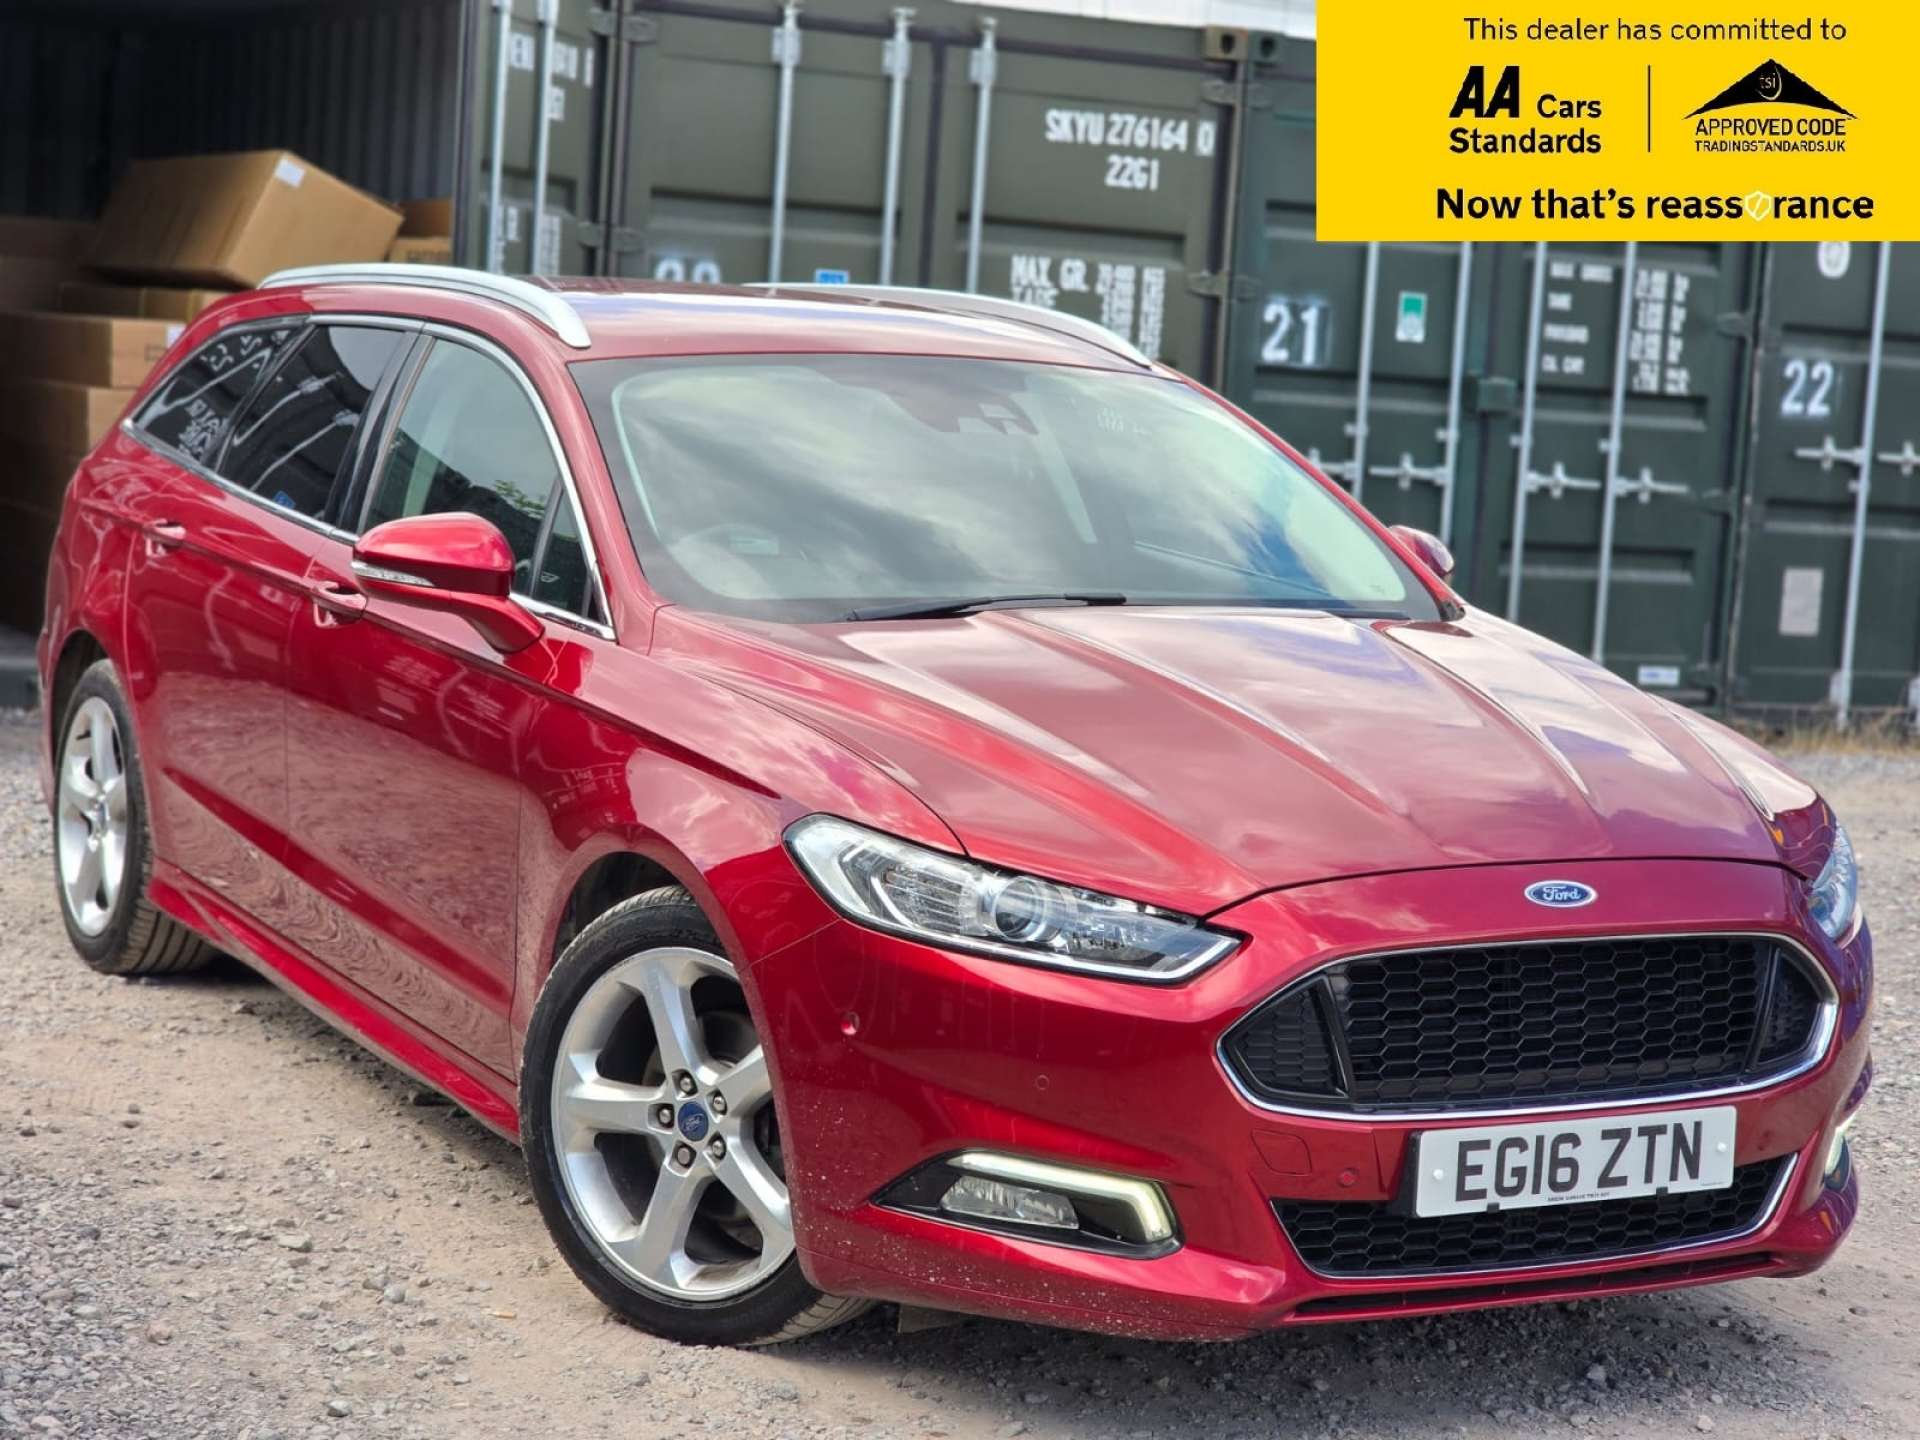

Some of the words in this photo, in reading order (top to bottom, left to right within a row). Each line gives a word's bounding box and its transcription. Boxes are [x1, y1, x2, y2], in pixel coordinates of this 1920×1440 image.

[1261, 302, 1319, 366] 21
[1780, 359, 1835, 417] 22
[1543, 886, 1581, 901] Ford
[1454, 1131, 1582, 1203] EG16
[1597, 1120, 1703, 1189] ZTN
